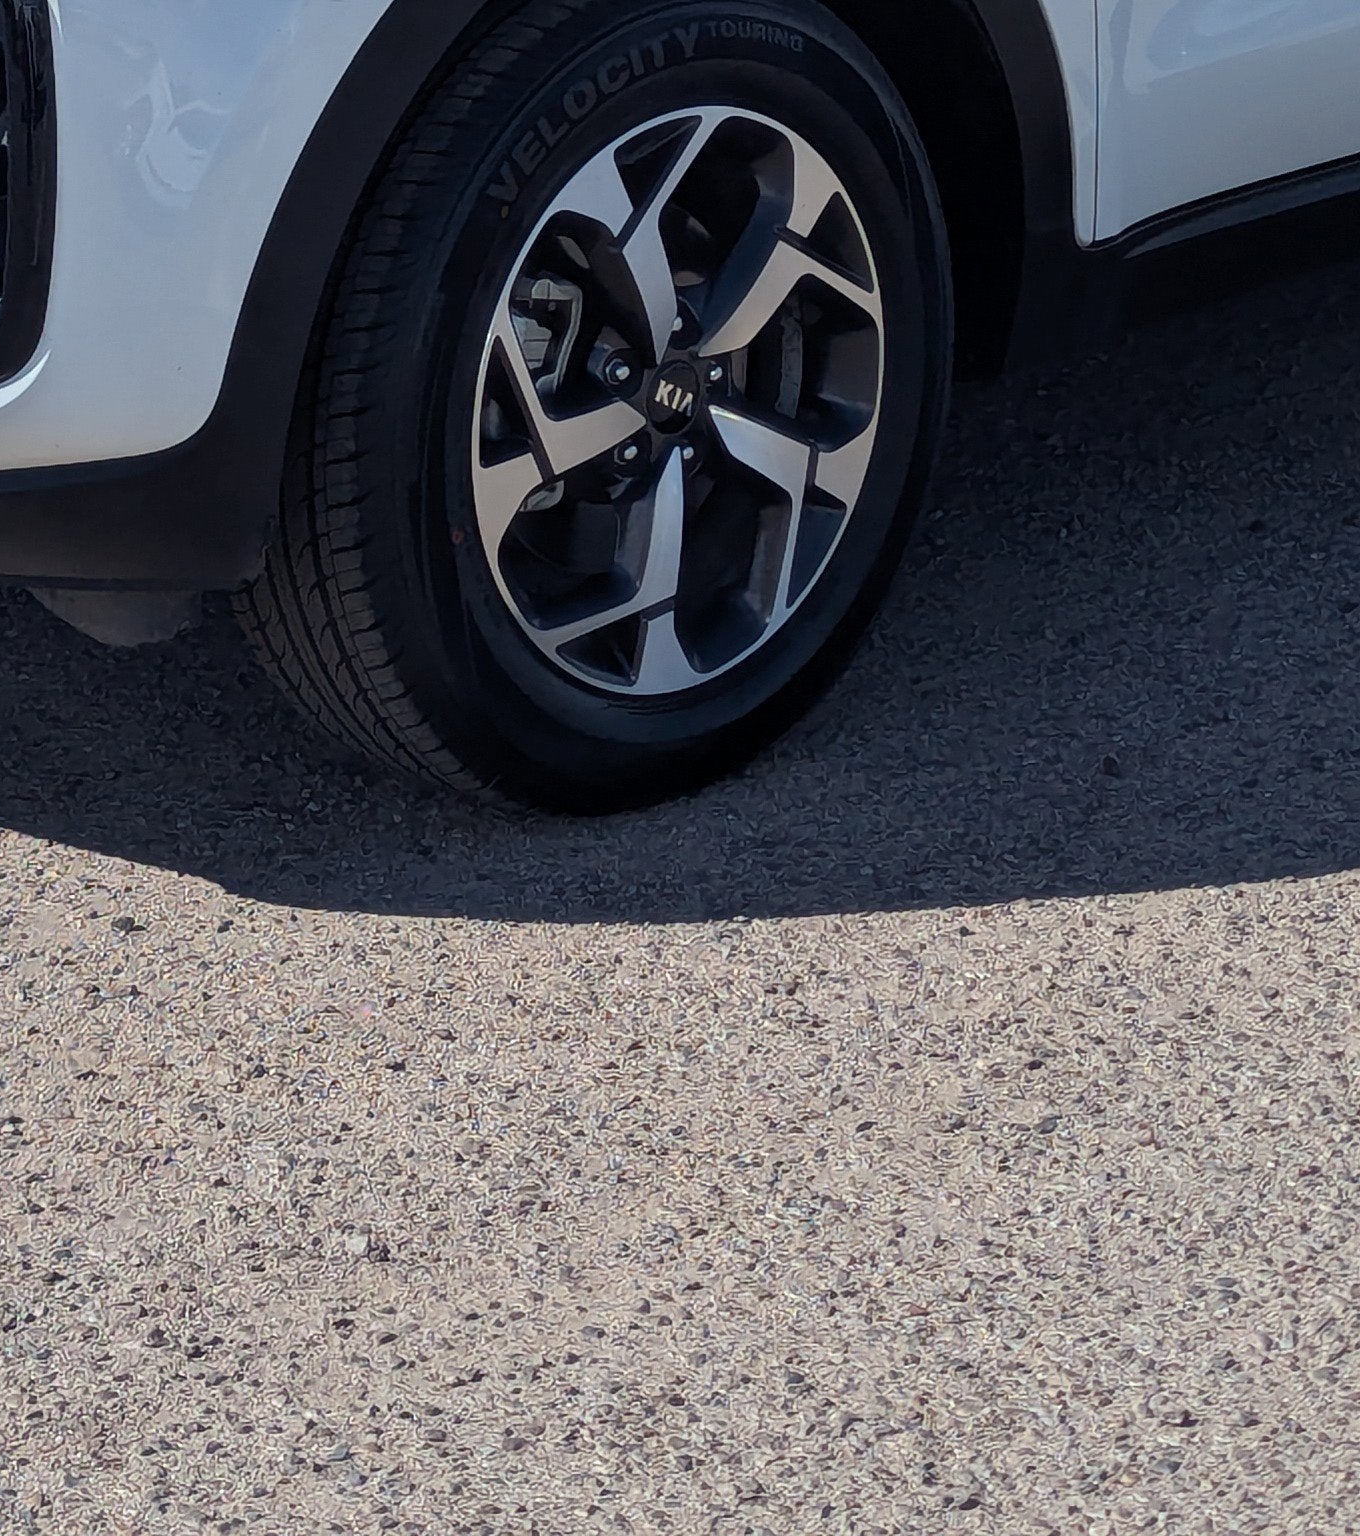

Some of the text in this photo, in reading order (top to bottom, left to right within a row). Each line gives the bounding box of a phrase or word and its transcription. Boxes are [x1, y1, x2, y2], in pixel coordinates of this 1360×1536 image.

[488, 19, 805, 203] VELOCITY TOURING
[654, 378, 694, 417] KIA
